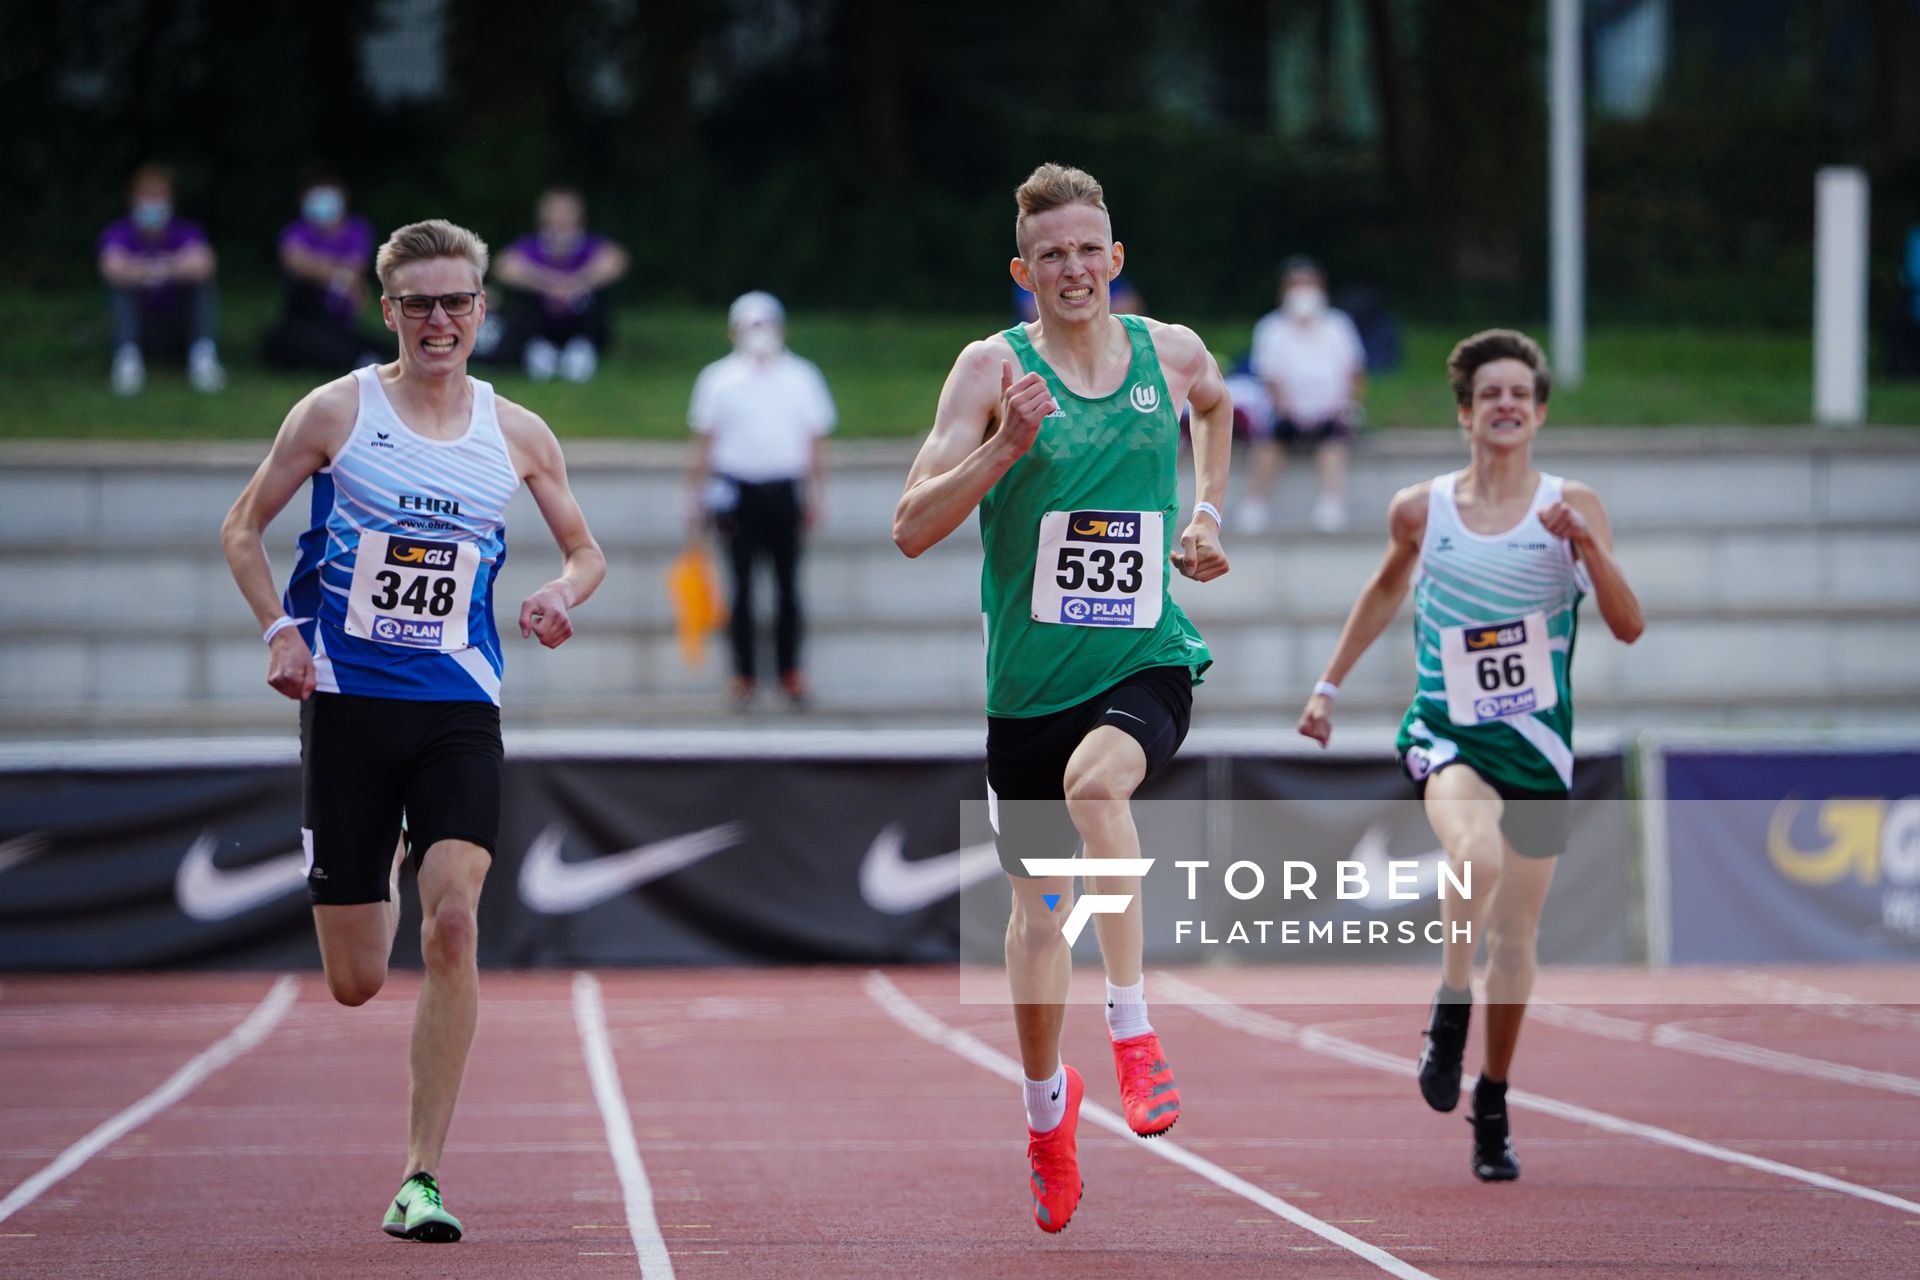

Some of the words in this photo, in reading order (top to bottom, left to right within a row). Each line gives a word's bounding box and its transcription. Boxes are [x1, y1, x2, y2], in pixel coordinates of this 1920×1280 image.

[371, 441, 394, 449] erima
[399, 495, 464, 516] EHRL
[1107, 521, 1135, 538] GLS
[424, 549, 453, 565] GLS
[1056, 547, 1144, 593] 533
[371, 570, 456, 617] 348
[1092, 603, 1132, 616] PLAN
[403, 624, 441, 638] PLAN
[1477, 653, 1526, 691] 66
